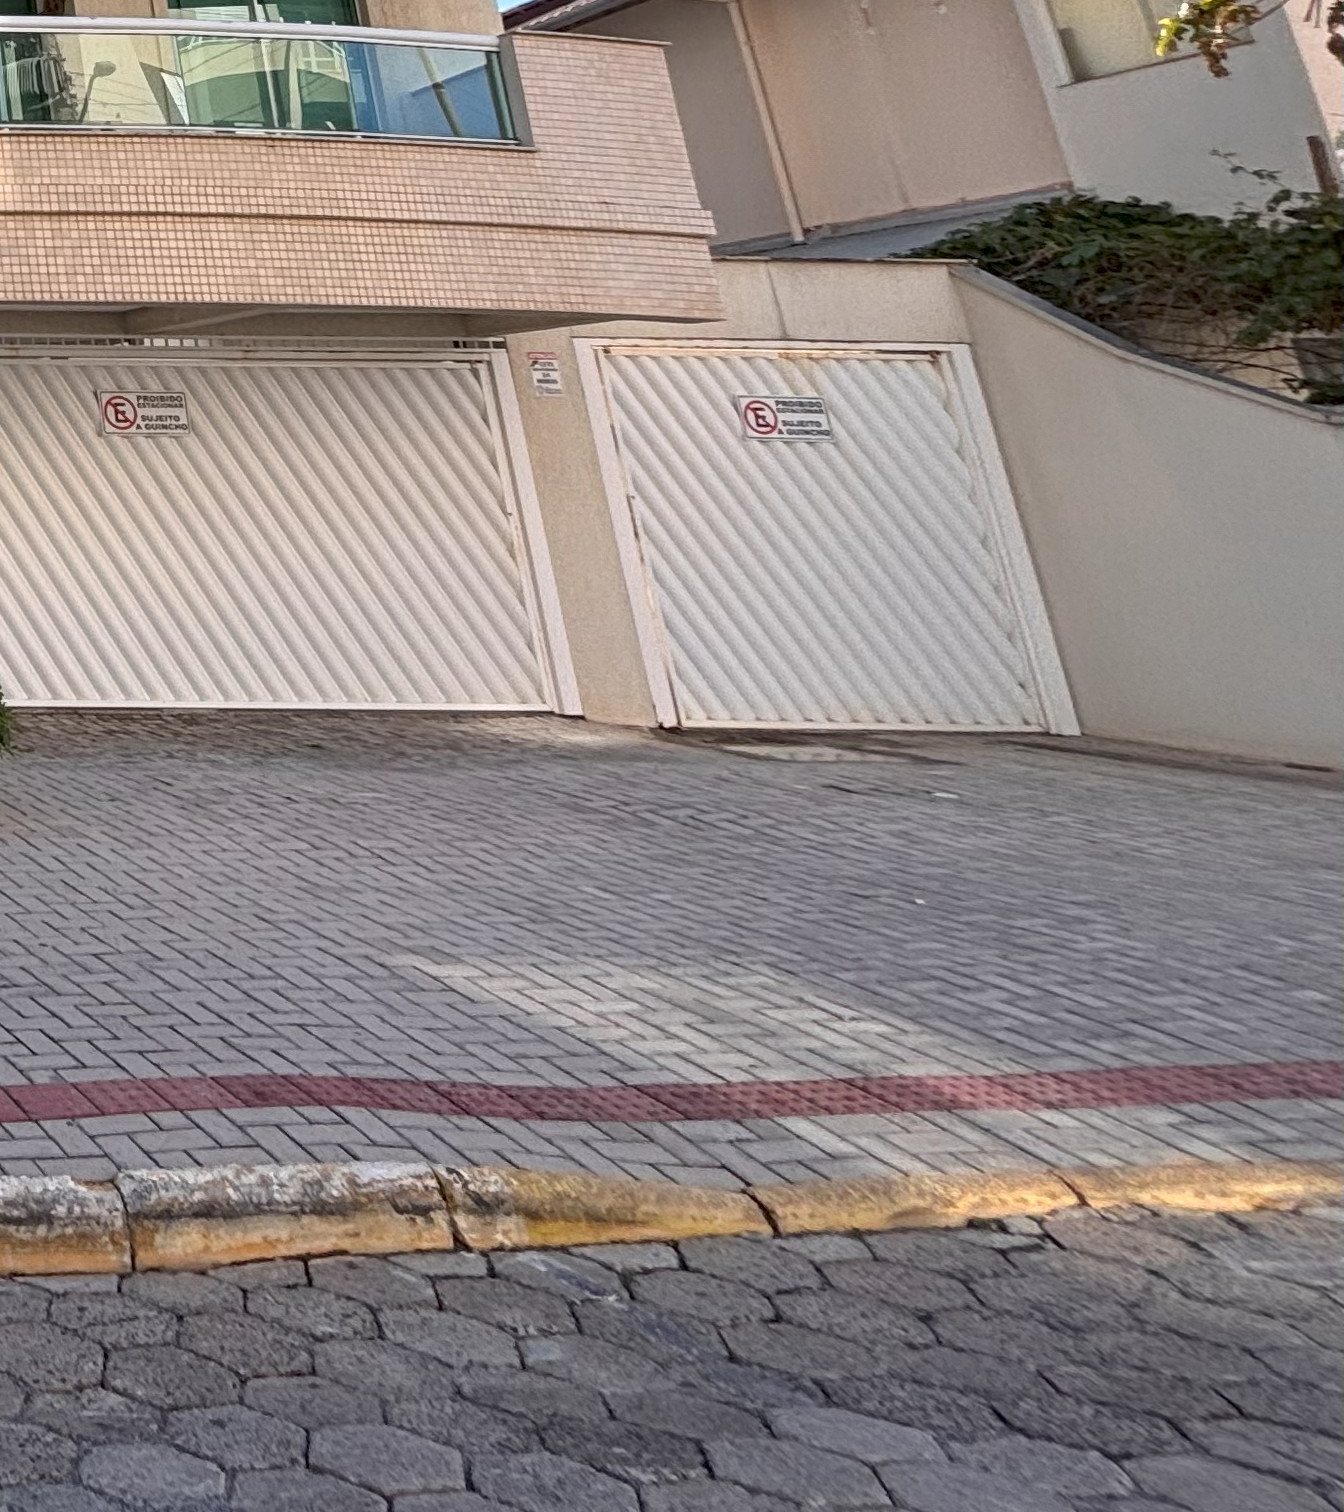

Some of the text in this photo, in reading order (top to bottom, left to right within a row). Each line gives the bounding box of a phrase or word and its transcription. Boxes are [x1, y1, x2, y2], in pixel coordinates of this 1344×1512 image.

[136, 395, 183, 403] PROIBIDO
[141, 414, 180, 422] SUJEITO
[144, 423, 188, 431] GUINCHO
